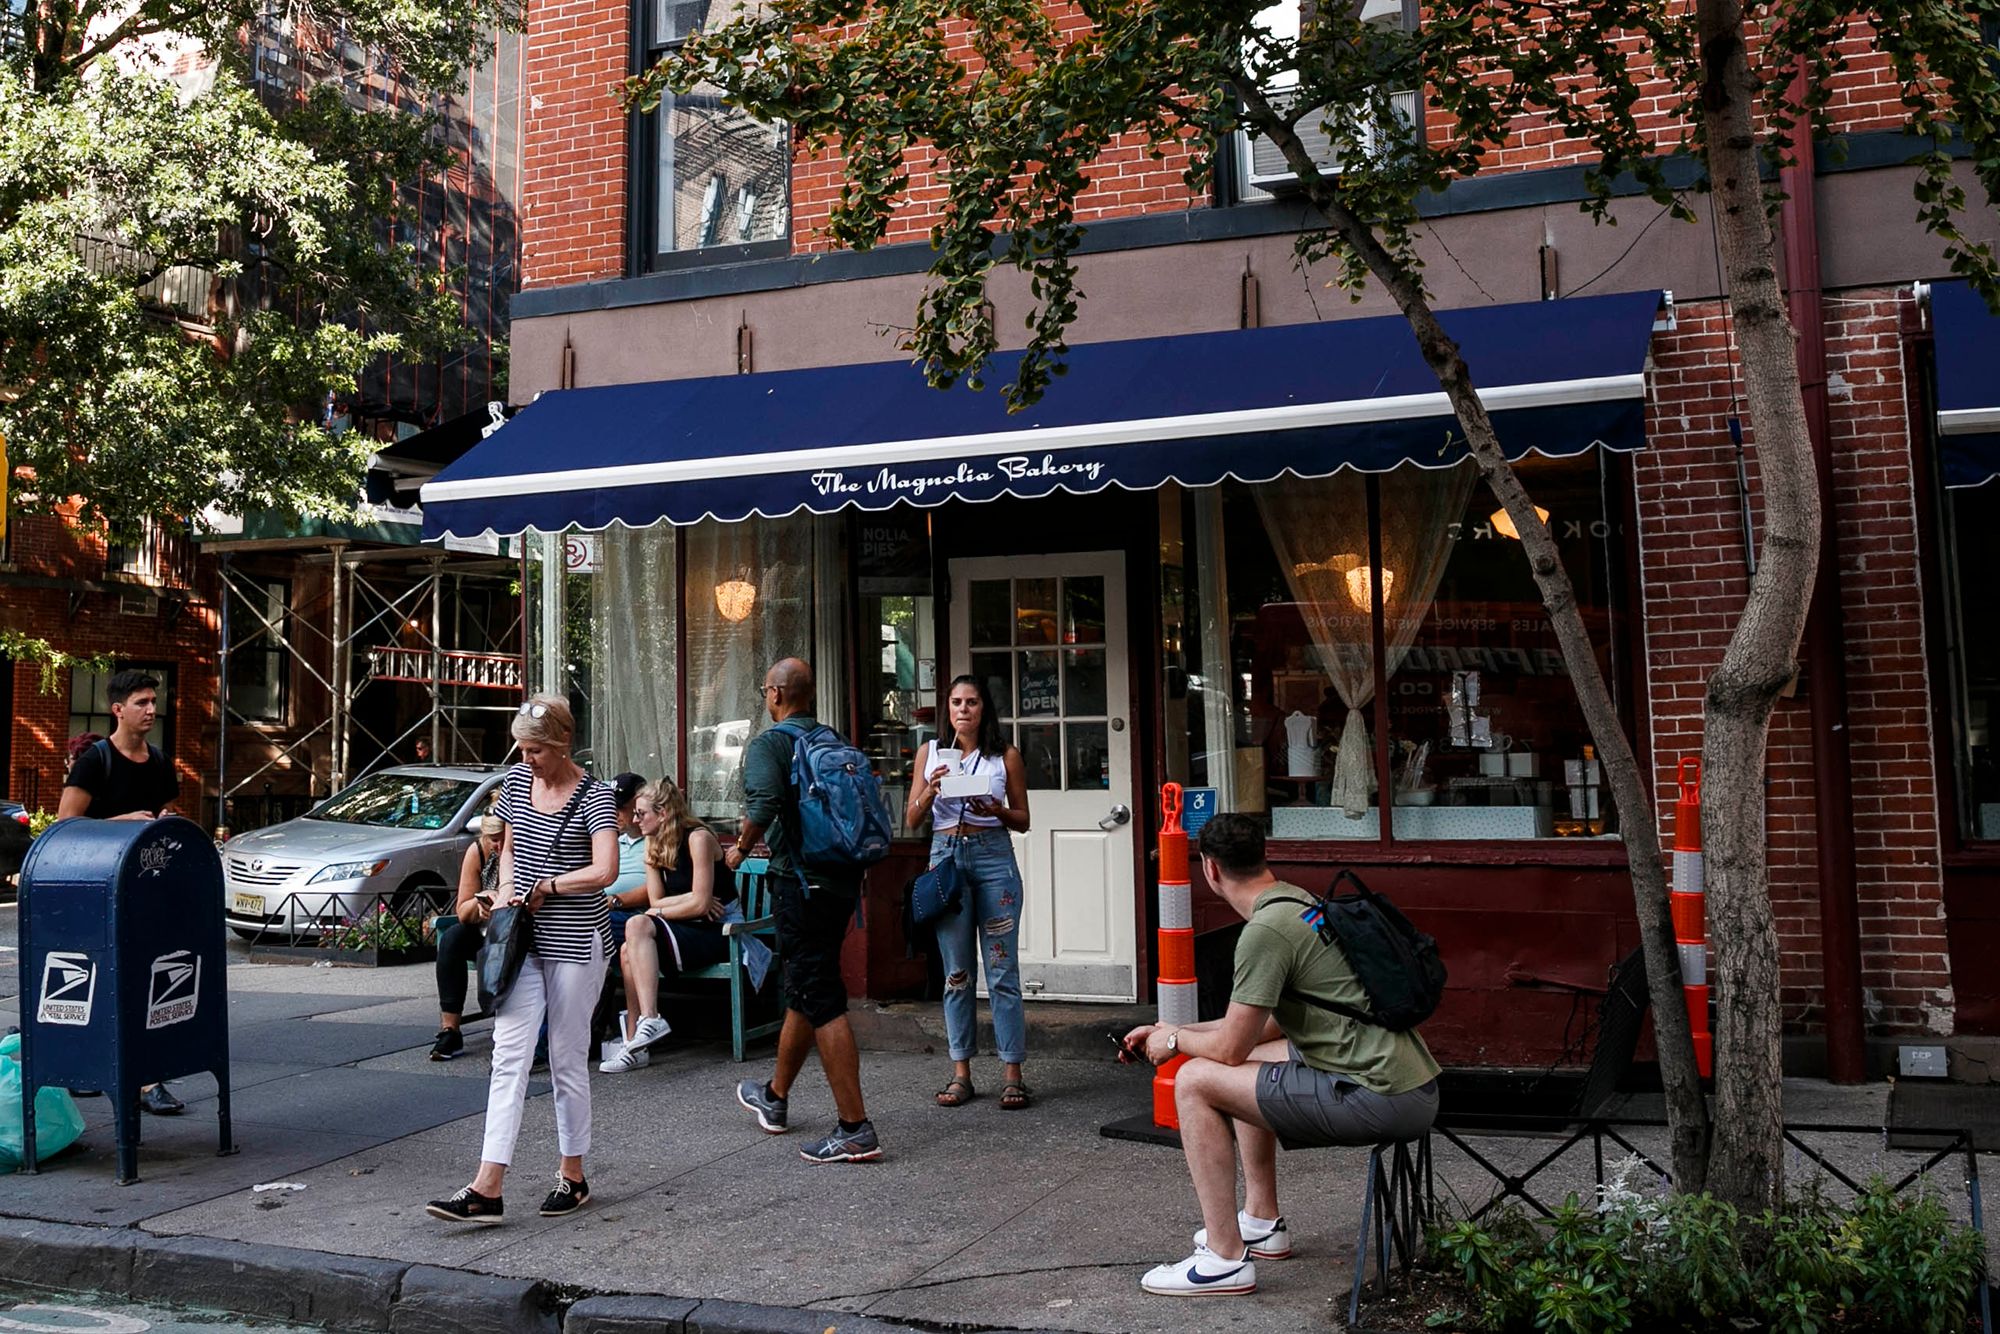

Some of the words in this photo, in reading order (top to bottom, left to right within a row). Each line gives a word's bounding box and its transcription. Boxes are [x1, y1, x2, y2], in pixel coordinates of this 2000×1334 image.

[811, 470, 862, 496] The
[867, 462, 994, 496] Magnolia
[998, 454, 1105, 480] Bakery
[1022, 696, 1059, 710] OPEN
[42, 1004, 64, 1012] UNITED
[65, 1005, 85, 1013] STATES
[64, 1012, 87, 1021] SERVICE
